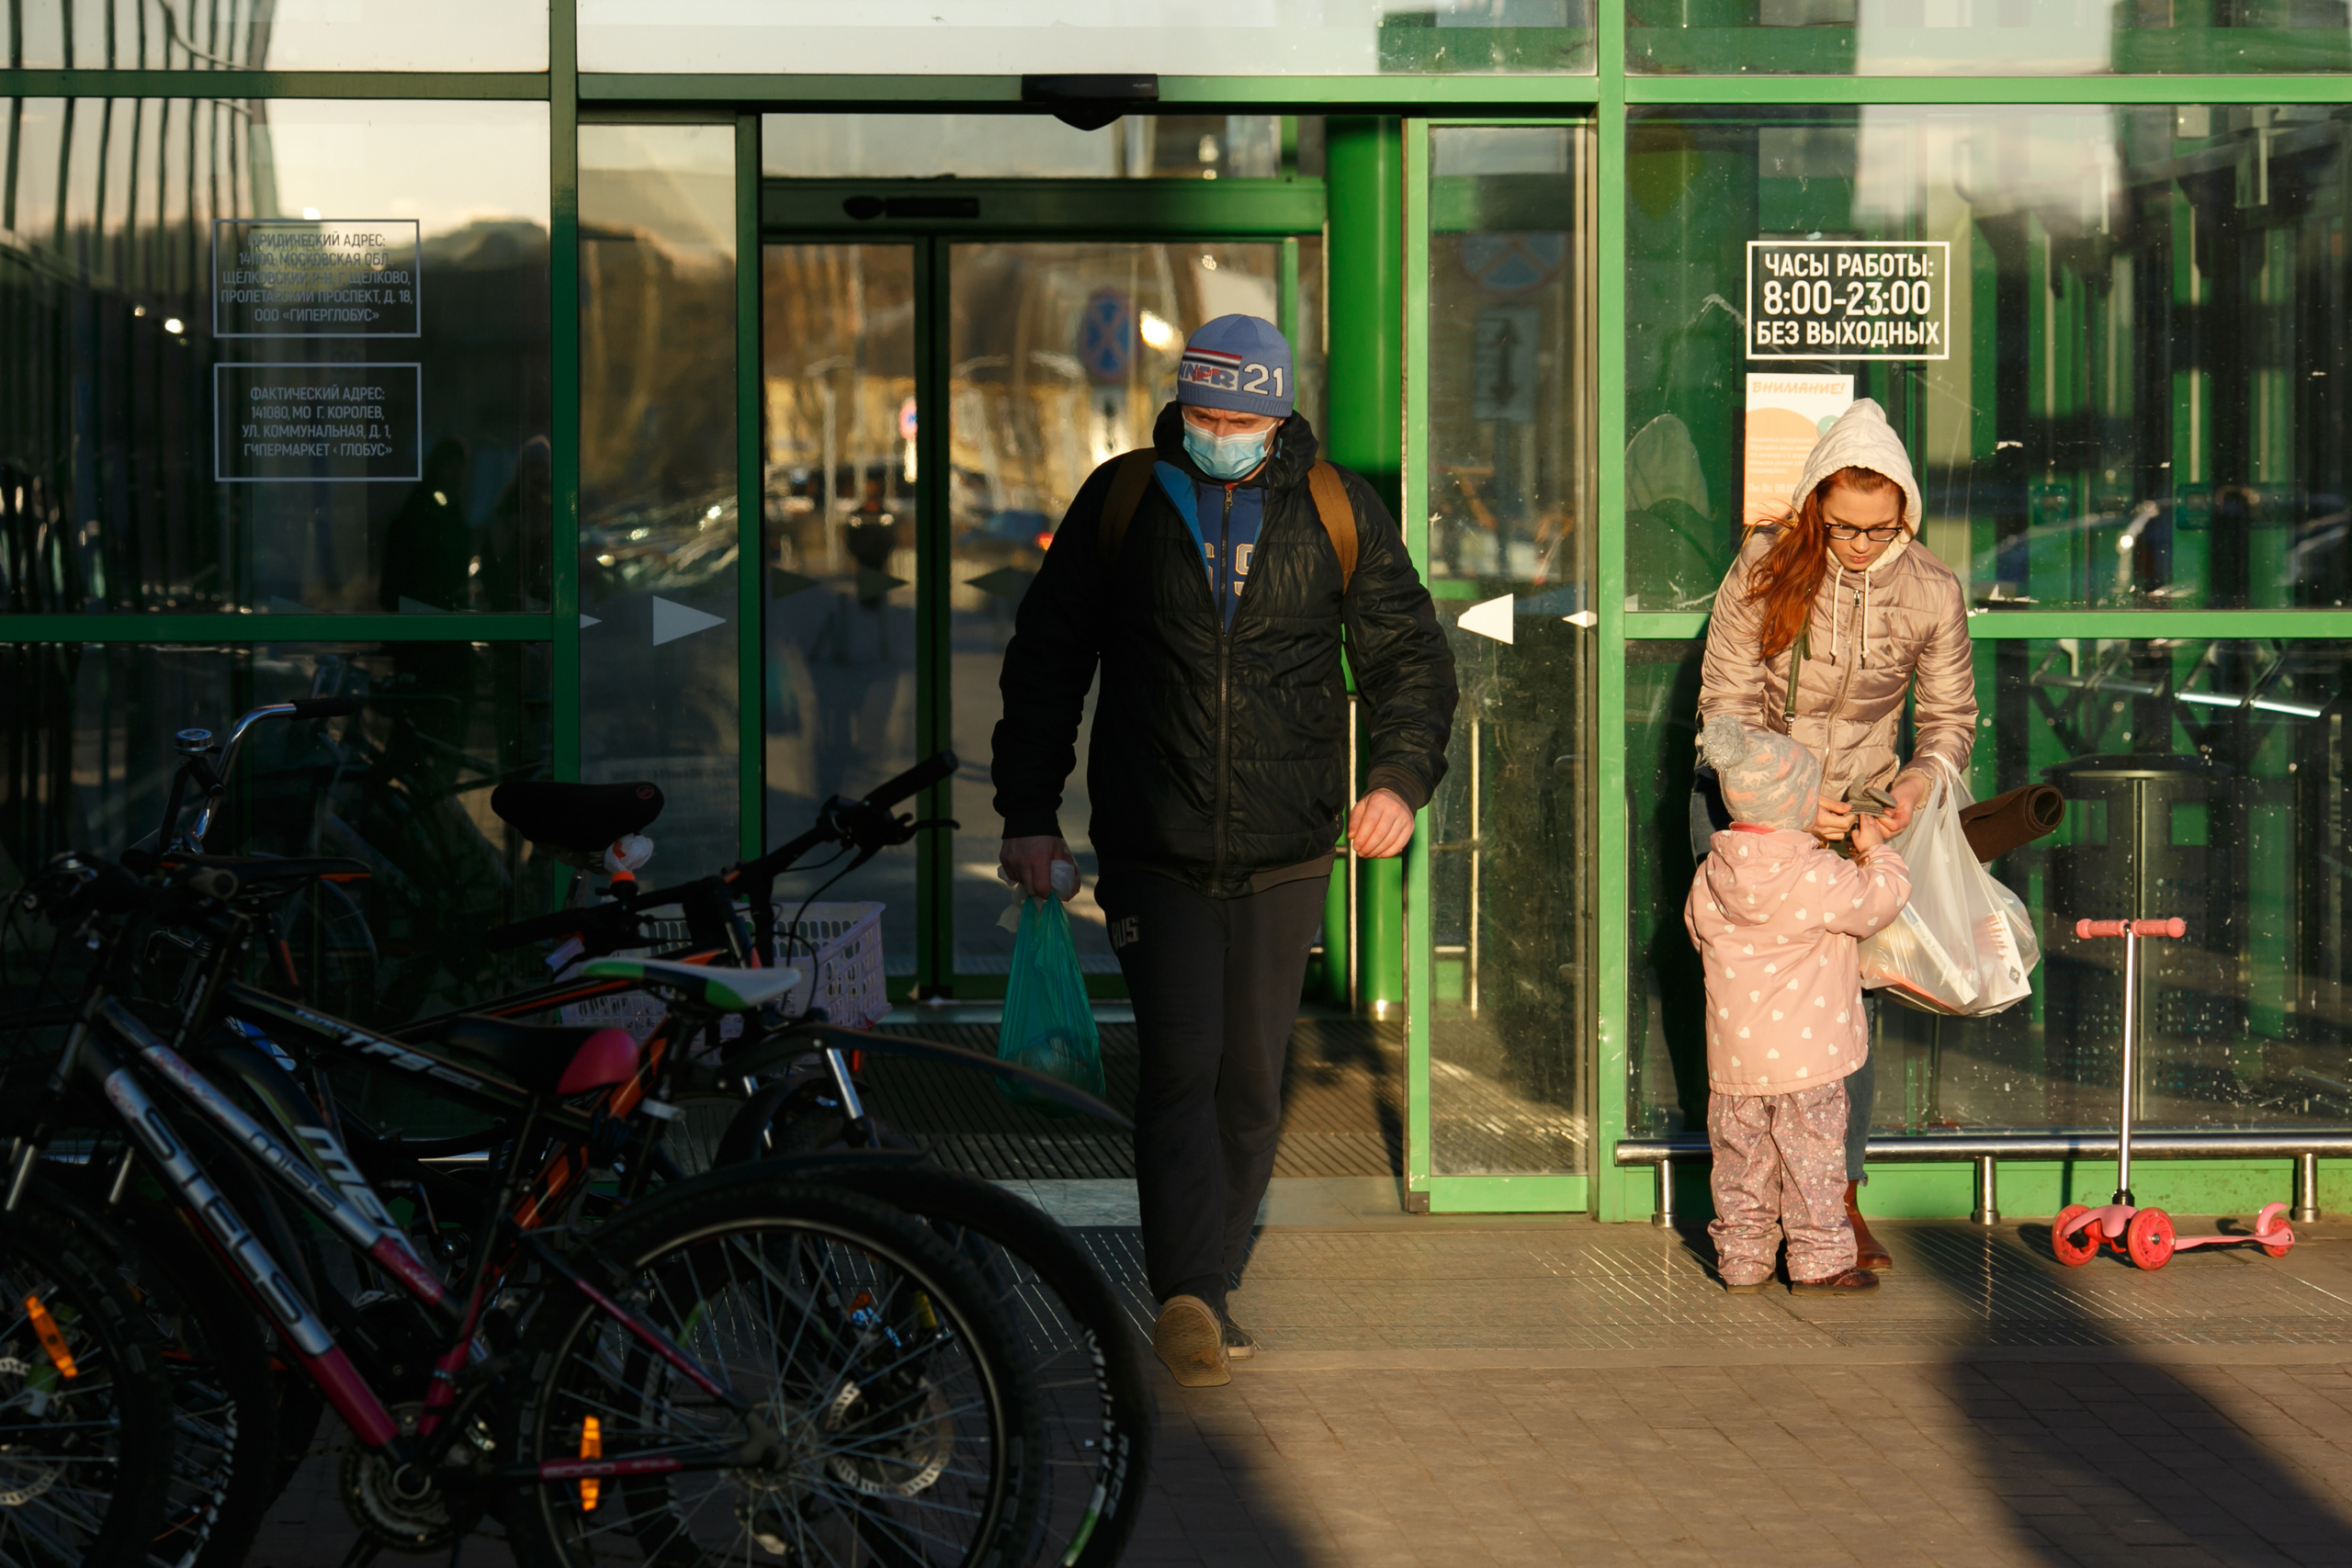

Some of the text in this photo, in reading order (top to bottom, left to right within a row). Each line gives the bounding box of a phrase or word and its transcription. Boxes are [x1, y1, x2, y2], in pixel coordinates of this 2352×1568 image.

[344, 233, 386, 248] АДРЕС:
[279, 253, 361, 265] МОСКОВСКАЯ
[1765, 254, 1934, 277] ЧАСЫ РАБОТЫ:
[220, 287, 413, 304] ПРОЛЕТАРСКИЙ ПРОСПЕКТ, Д. 18,
[1763, 280, 1931, 316] 8:00-23:00
[254, 308, 279, 321] ООО
[1757, 321, 1939, 348] БЕЗ ВЫХОДНЫХ
[1242, 362, 1284, 399] 21
[1751, 381, 1847, 395] ВНИМАНИЕ!
[250, 384, 385, 401] ФАКТИЧЕСКИЙ АДРЕС:
[251, 406, 290, 420] 141080,
[317, 406, 324, 419] Г.
[327, 406, 385, 421] КОРОЛЕВ,
[242, 424, 391, 439] УЛ. КОММУНАЛЬНАЯ, Д. 1,
[244, 443, 330, 457] ГИПЕРМАРКЕТ
[1110, 914, 1140, 952] RUS
[131, 1107, 301, 1324] STELS
